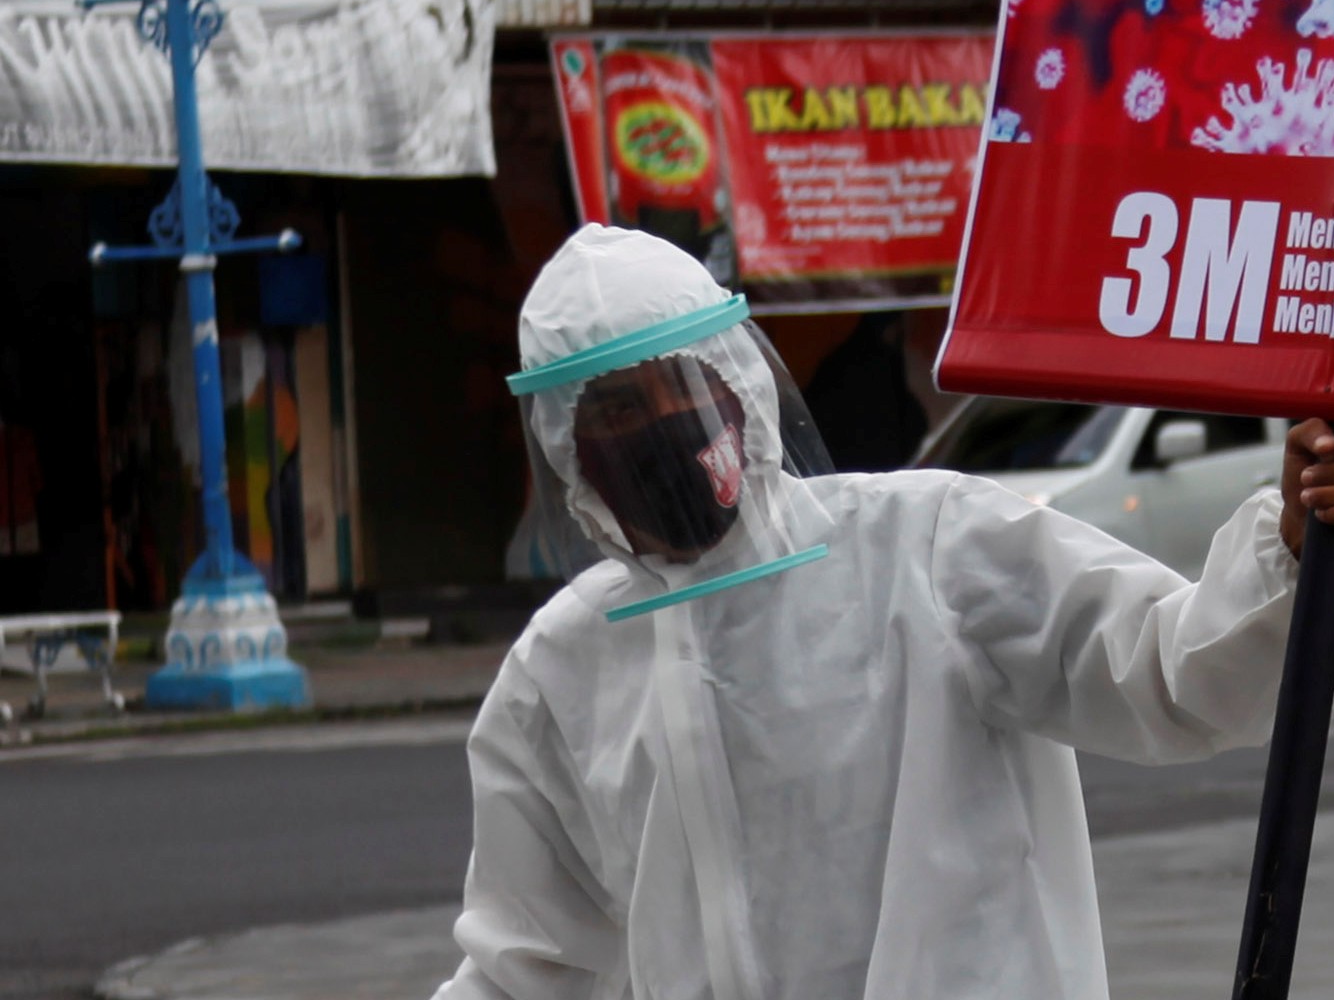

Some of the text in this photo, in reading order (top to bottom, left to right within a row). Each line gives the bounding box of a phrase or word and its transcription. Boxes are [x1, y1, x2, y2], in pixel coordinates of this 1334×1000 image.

[746, 86, 858, 132] IKAN
[864, 84, 989, 129] BAKA
[1099, 191, 1281, 344] 3M
